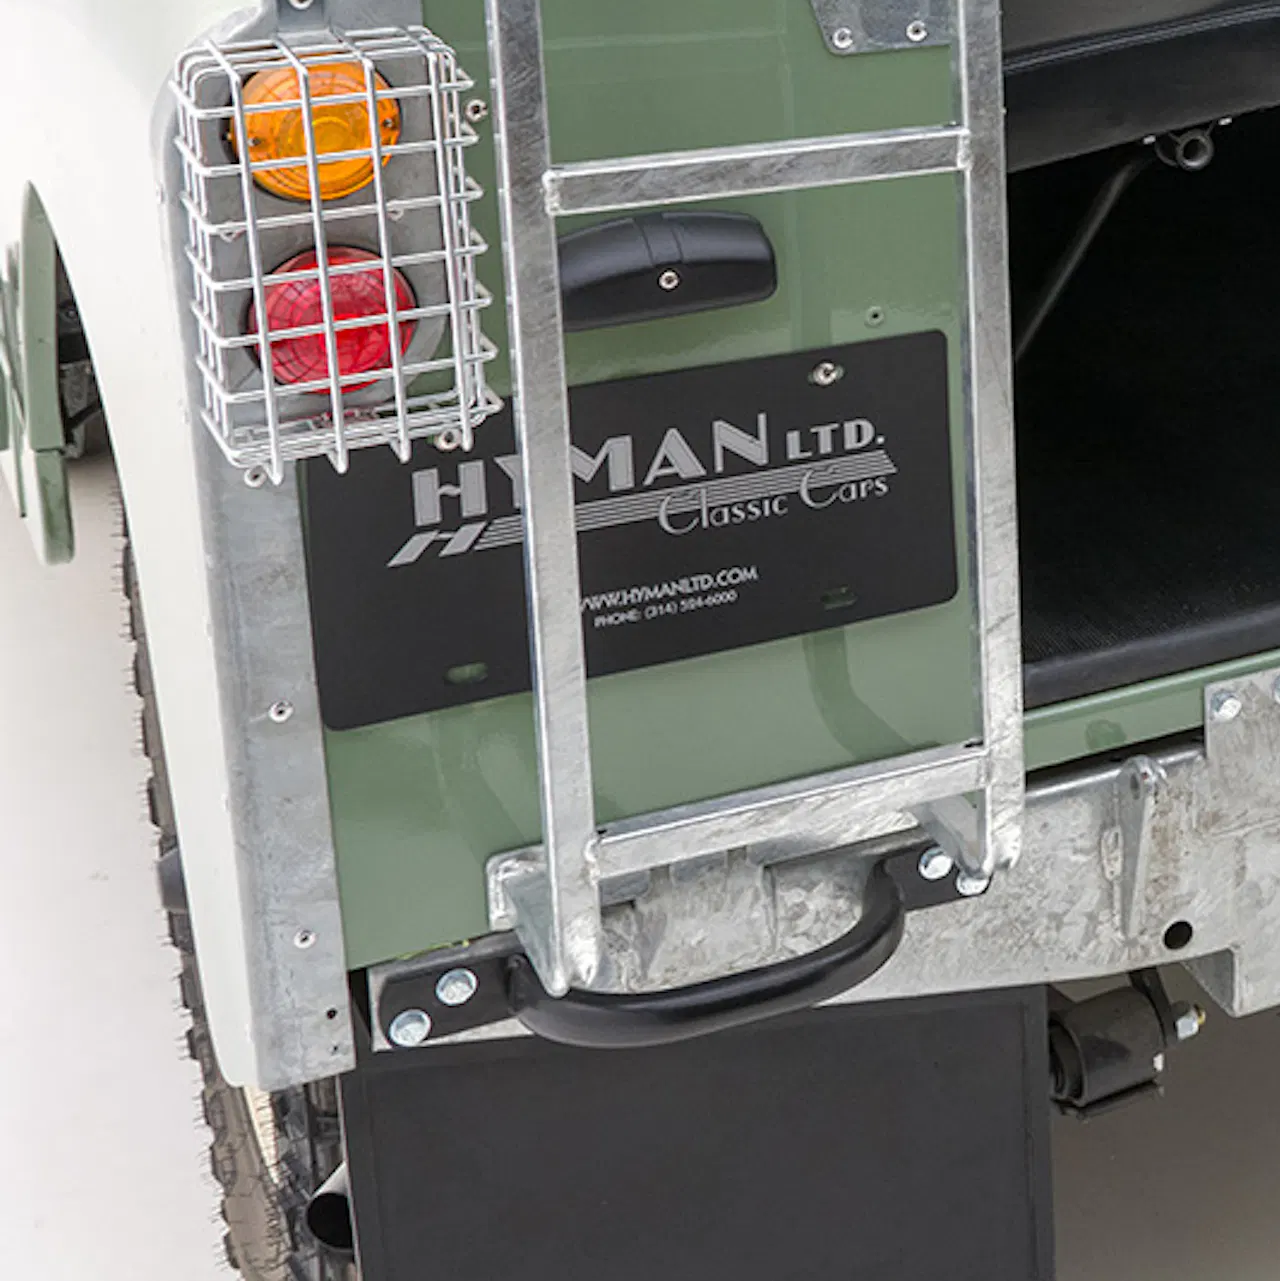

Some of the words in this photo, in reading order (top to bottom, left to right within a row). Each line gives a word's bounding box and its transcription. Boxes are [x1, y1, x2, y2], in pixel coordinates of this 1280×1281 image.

[785, 418, 885, 460] LTD.
[657, 485, 789, 535] Classic
[799, 465, 889, 509] Cars
